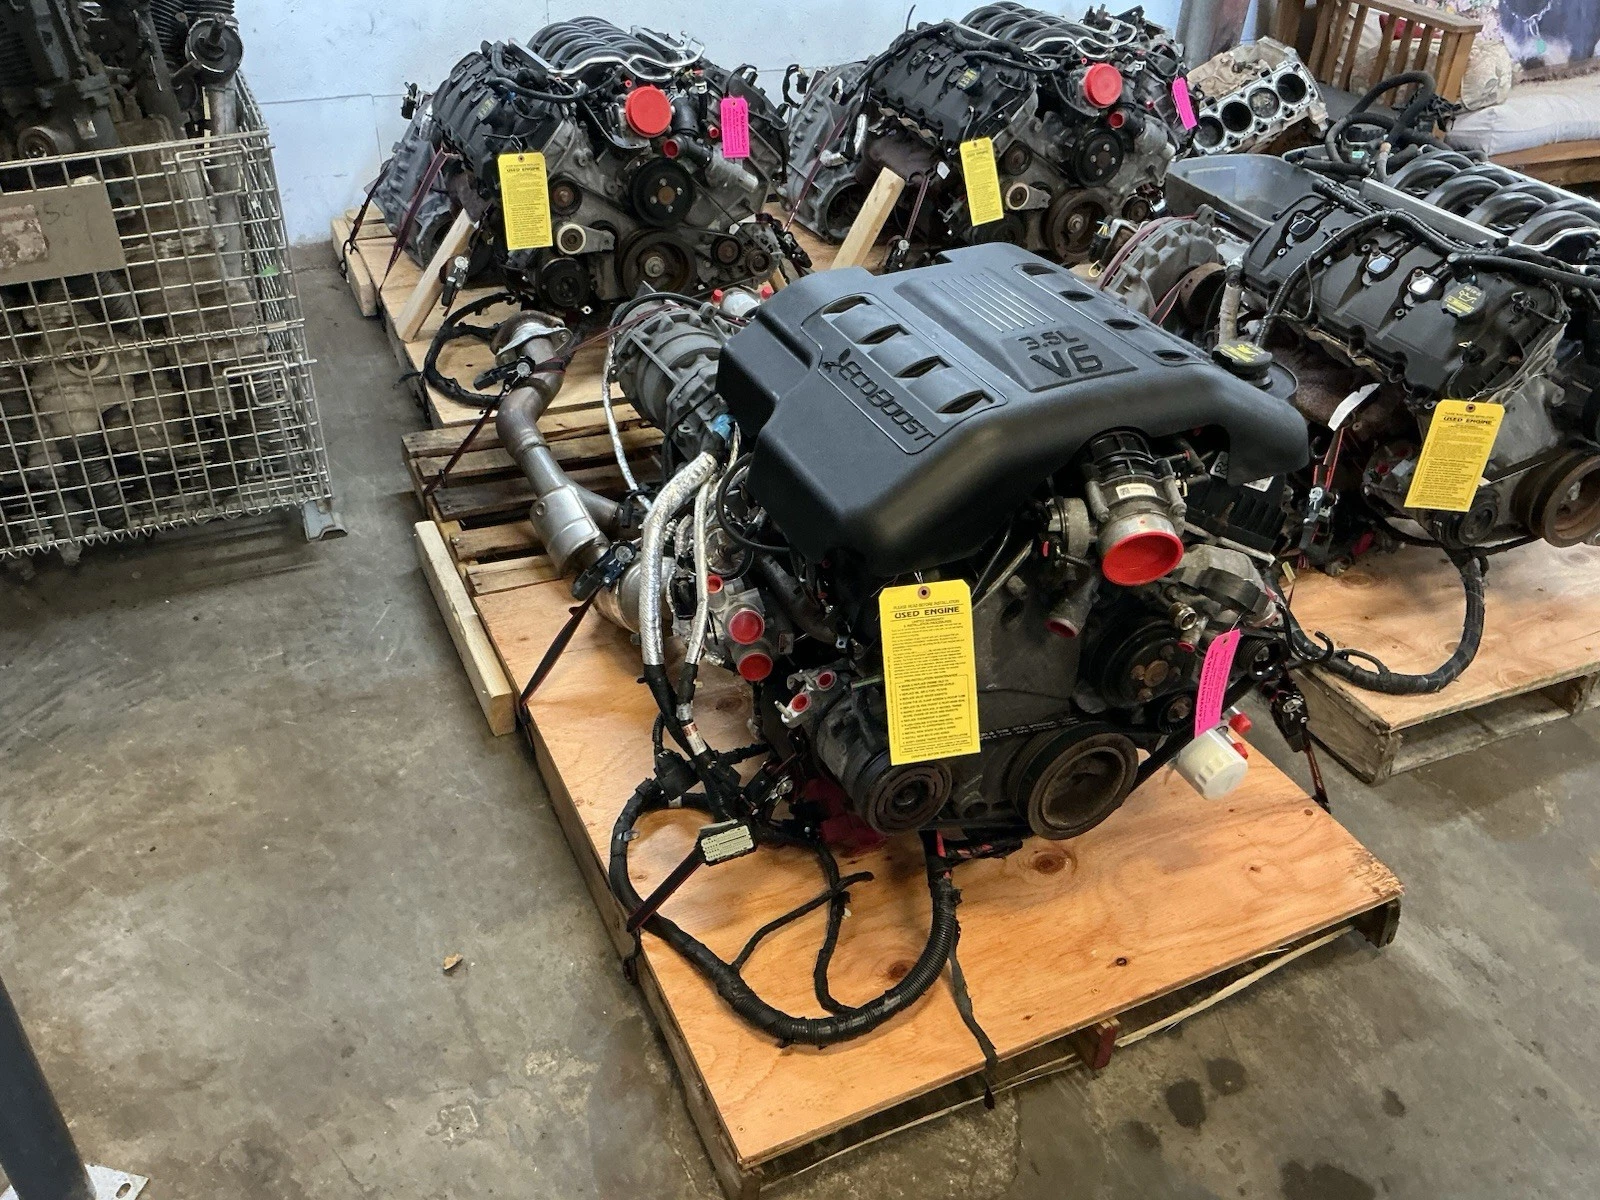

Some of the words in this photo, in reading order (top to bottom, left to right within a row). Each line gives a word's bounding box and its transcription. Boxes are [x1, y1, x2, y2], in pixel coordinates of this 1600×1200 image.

[1018, 330, 1080, 351] 3.5L
[1029, 344, 1104, 379] V6
[894, 610, 920, 619] USED
[924, 606, 960, 616] ENGINE
